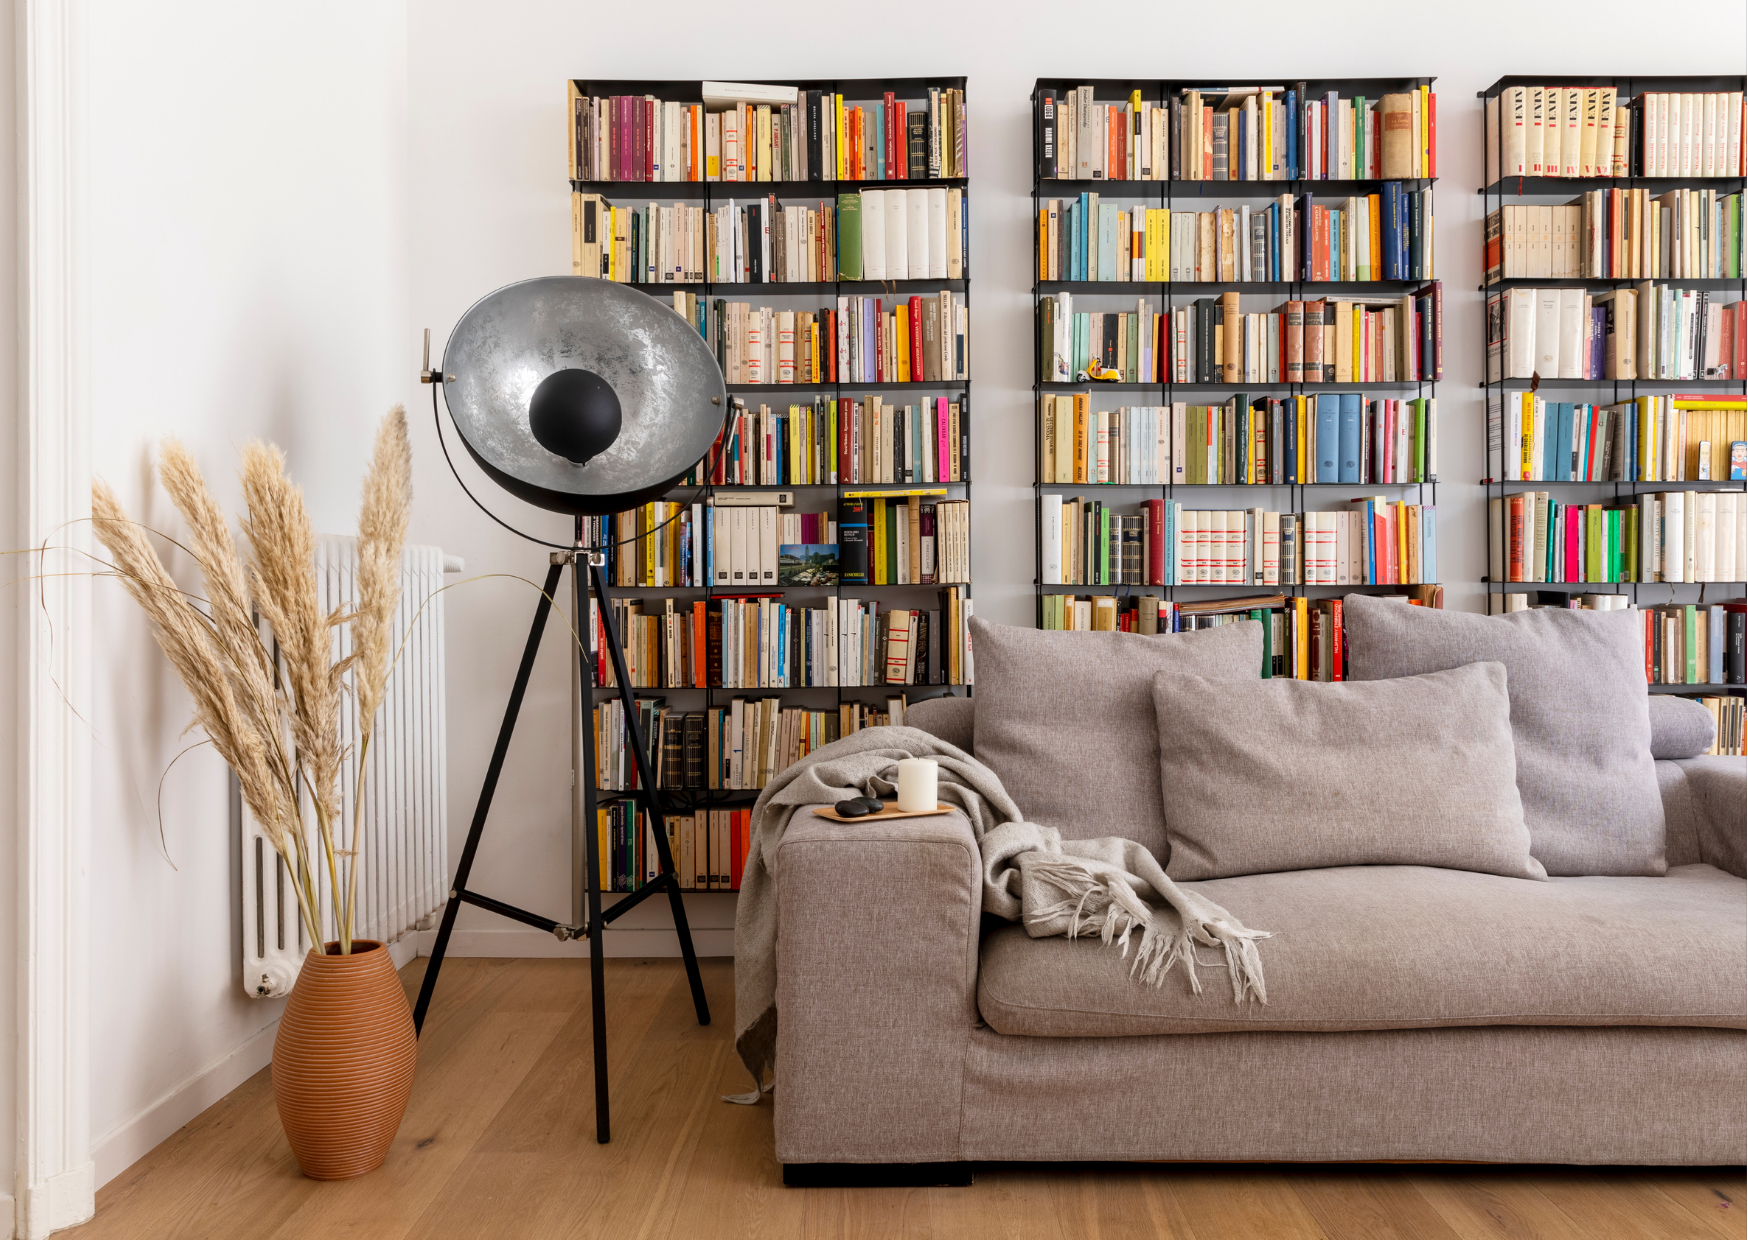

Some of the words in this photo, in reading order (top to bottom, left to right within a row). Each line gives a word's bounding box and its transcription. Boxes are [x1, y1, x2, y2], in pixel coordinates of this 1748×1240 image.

[1534, 90, 1542, 126] LENIN
[1569, 91, 1577, 127] LENIN
[1588, 90, 1596, 126] LENIN
[1601, 91, 1611, 128] LENIN
